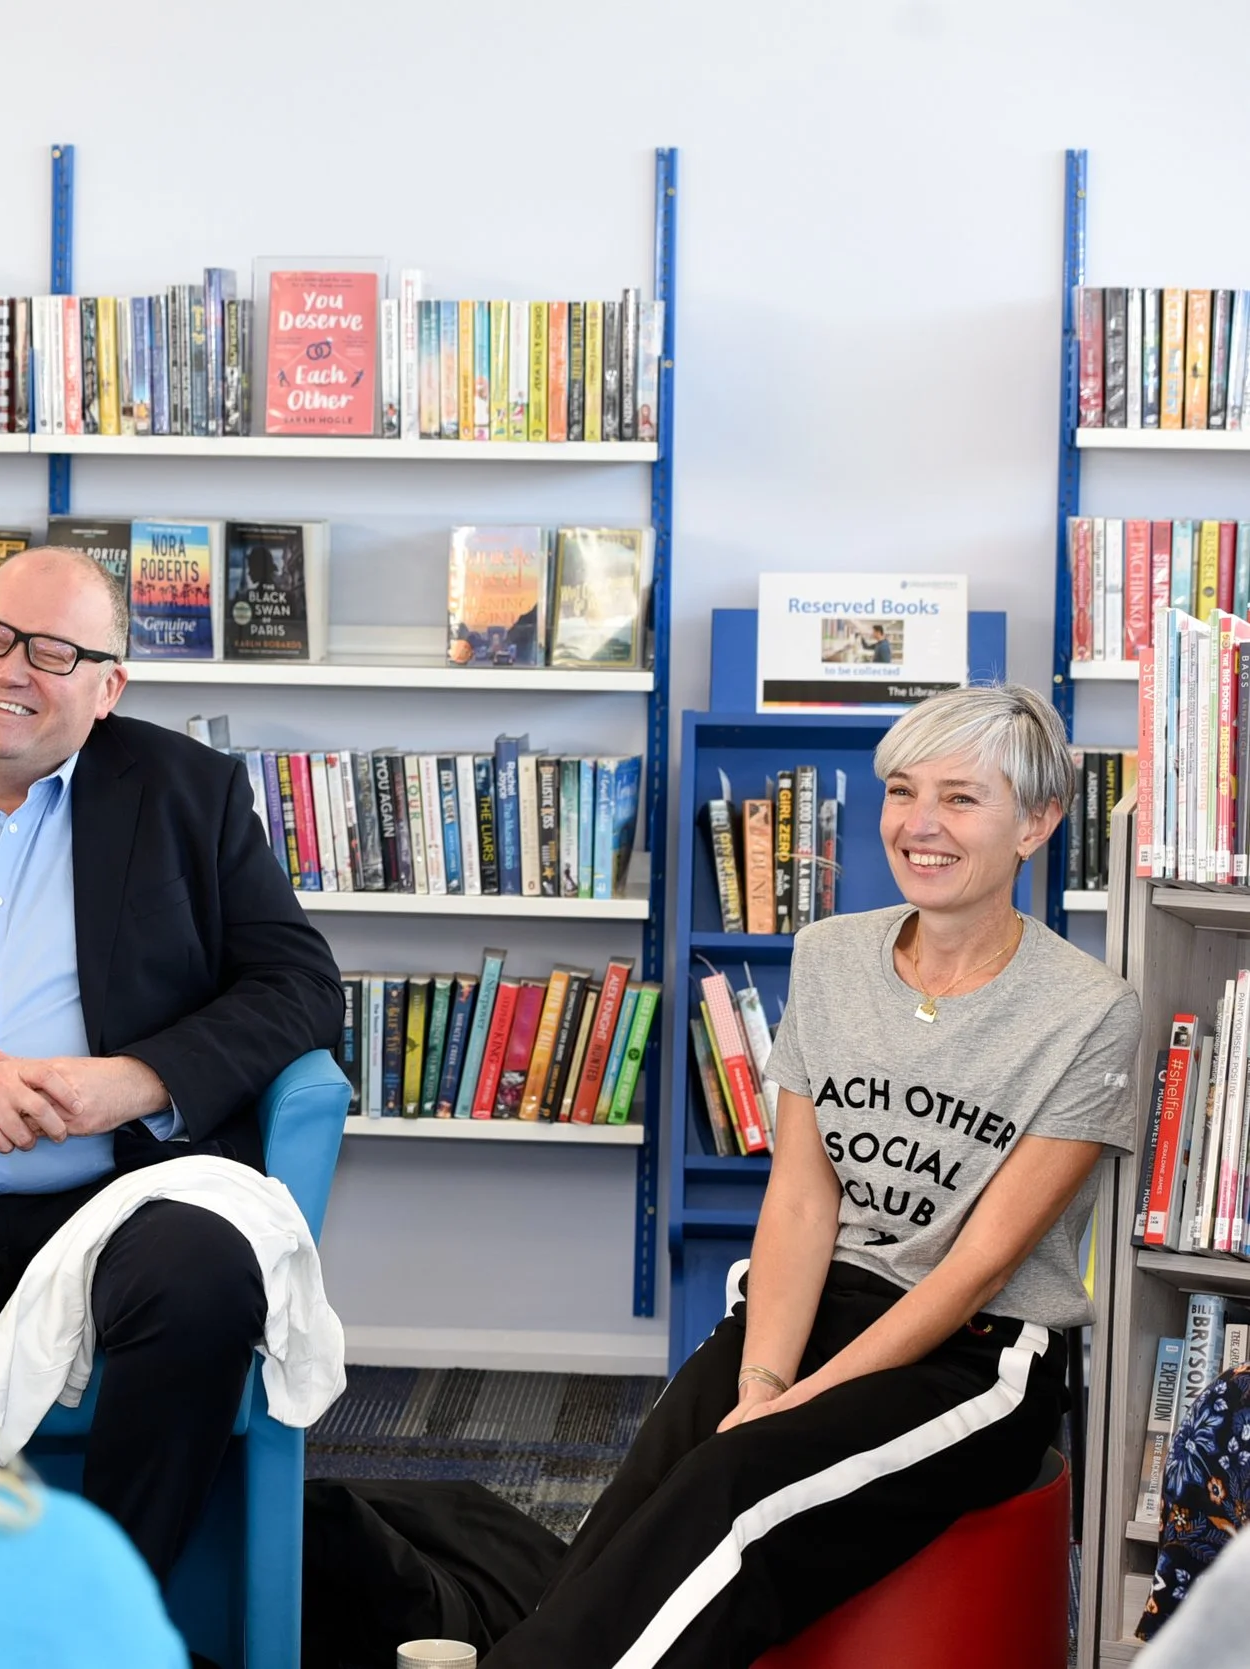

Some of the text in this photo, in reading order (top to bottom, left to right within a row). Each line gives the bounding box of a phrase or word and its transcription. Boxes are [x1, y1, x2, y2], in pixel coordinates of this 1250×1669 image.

[278, 310, 363, 332] Deserve
[302, 291, 344, 312] You
[295, 364, 347, 385] Each
[287, 391, 354, 411] Other
[87, 547, 128, 559] PORTER
[151, 534, 186, 557] NORA
[1203, 530, 1217, 582] RUSSELL
[140, 558, 200, 582] ROBERTS
[1130, 542, 1147, 629] PACHINKO
[249, 591, 287, 604] BLACK
[255, 604, 291, 616] SWAN
[788, 598, 939, 616] Reserved Books
[143, 617, 197, 633] Genuine
[155, 632, 186, 645] LIES
[250, 624, 286, 637] PARIS
[825, 666, 900, 677] to be collected
[1144, 663, 1155, 700] SEW
[1222, 653, 1230, 667] THE
[1222, 669, 1231, 684] BIG
[887, 686, 907, 697] The
[1222, 686, 1231, 711] BOOK
[1239, 655, 1249, 757] BAGS ANNA ALICIA
[1155, 691, 1164, 743] COLLECTION
[1198, 704, 1210, 811] visible mending
[1219, 726, 1230, 779] DRESSING
[376, 760, 395, 838] YOU AGAIN
[408, 774, 421, 820] FOUR
[497, 769, 508, 799] Joyce
[506, 761, 517, 797] Rachel
[539, 766, 556, 829] BALLISTIC KISS
[1086, 771, 1097, 820] ARDNISH
[1106, 760, 1116, 811] HAPPY EVER
[1219, 781, 1229, 796] UP
[480, 796, 494, 861] THE LIARS
[503, 802, 514, 870] The Music Shop
[778, 790, 792, 863] GIRL ZERO
[797, 771, 812, 912] THE BLOOD DIVIDE DHAND
[752, 850, 768, 906] DUNE
[477, 979, 496, 1030] Sleepover
[571, 981, 580, 990] THE
[641, 995, 654, 1013] COLD
[448, 1012, 465, 1065] MIRACLE CREEK
[488, 995, 511, 1064] STEPHEN KING
[537, 979, 565, 1051] WHEN WE FALL
[586, 974, 620, 1082] ALEX KNIGHT HUNTED
[1209, 1012, 1224, 1084] Watercolour Painting
[1228, 992, 1246, 1099] PAINT YOURSELF POSITIVE
[623, 1061, 637, 1083] DAVID
[733, 1067, 745, 1091] PASTA
[807, 1076, 1017, 1152] ACH OTHER
[1155, 1058, 1185, 1195] #shelfie GERALDINE JAMES
[825, 1130, 962, 1192] SOCIAL
[1140, 1088, 1167, 1217] HOME SWEET RENTED HOME
[844, 1179, 937, 1227] CLUB
[1191, 1304, 1215, 1315] BILL
[1185, 1316, 1211, 1400] BRYSON
[1230, 1330, 1241, 1347] THE
[1153, 1362, 1178, 1422] EXPEDITION
[1148, 1434, 1165, 1494] STEVE BACKSHALL
